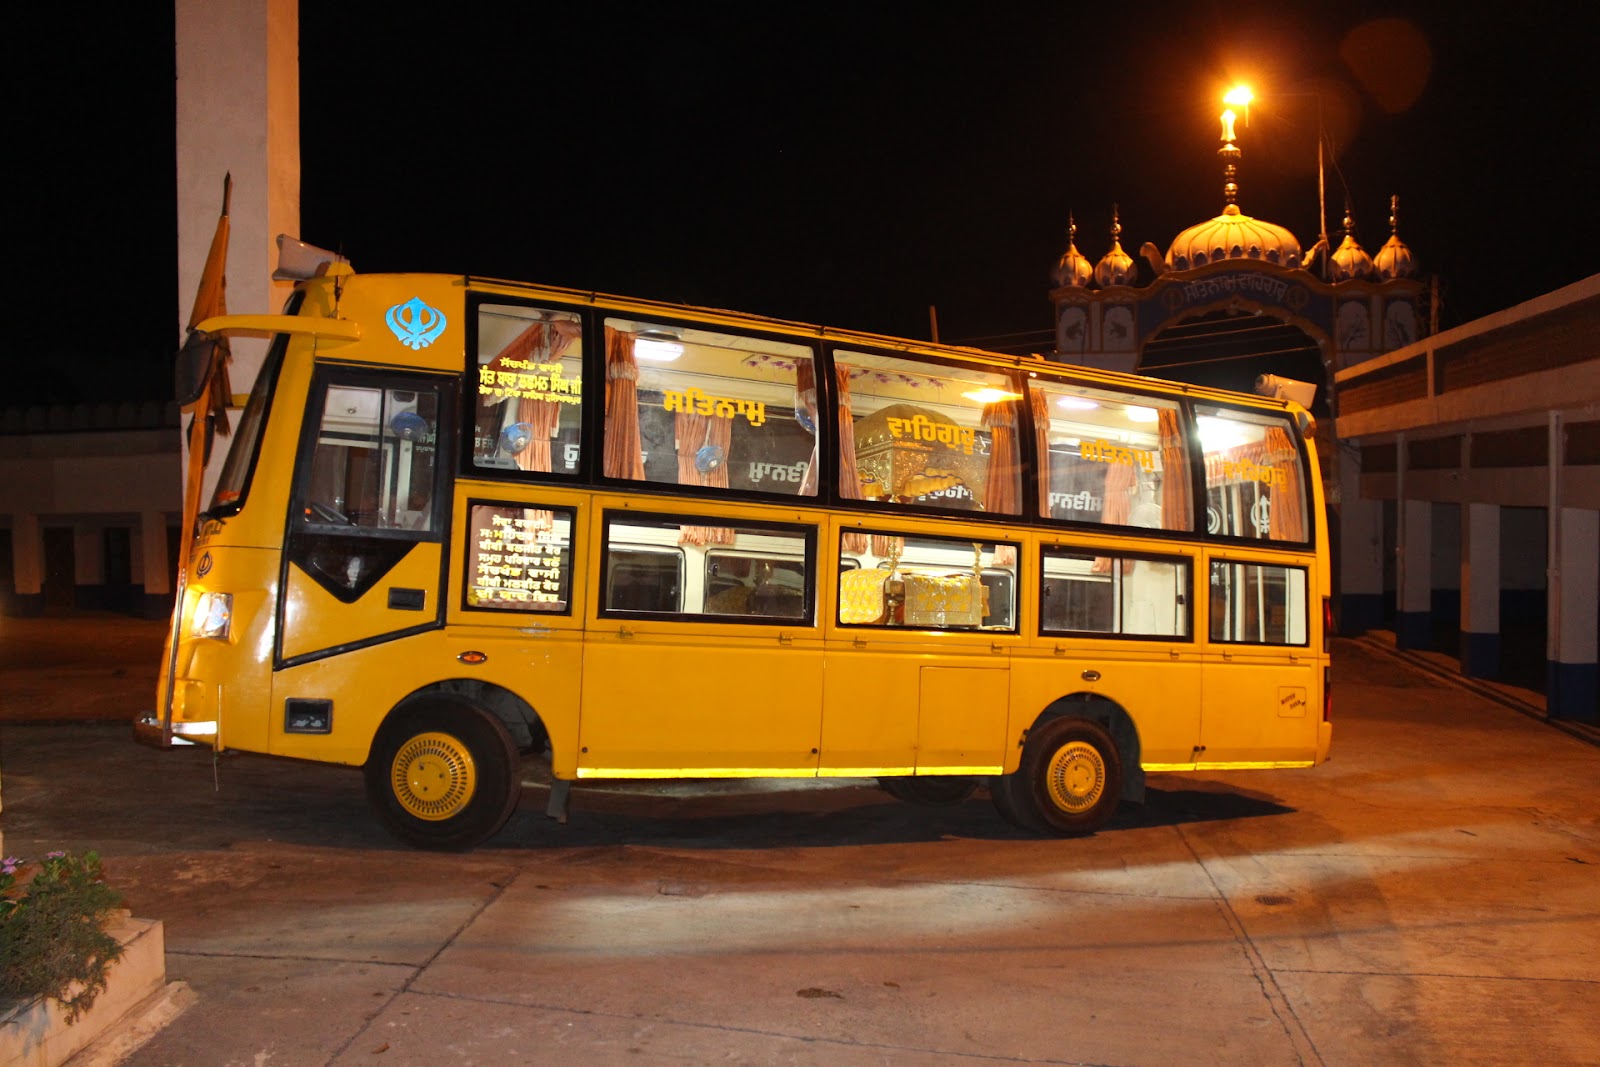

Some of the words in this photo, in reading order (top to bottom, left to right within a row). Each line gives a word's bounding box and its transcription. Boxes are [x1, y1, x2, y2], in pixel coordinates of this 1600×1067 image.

[479, 365, 496, 385] ਸੰਤ
[497, 371, 517, 388] ਬਾਬਾ
[662, 387, 766, 427] ਸਤਿਨਾਮੁ
[887, 415, 976, 455] ਵਾਹਿਗੁਰੂ
[1079, 438, 1155, 473] ਸਤਿਨਾਮੁ
[1223, 457, 1289, 493] ਵਾਹਿਗੁਰੂ
[479, 539, 503, 551] ਬੀਬੀ
[476, 575, 501, 587] ਬੀਬੀ
[528, 567, 560, 579] ਵਾਸੀ
